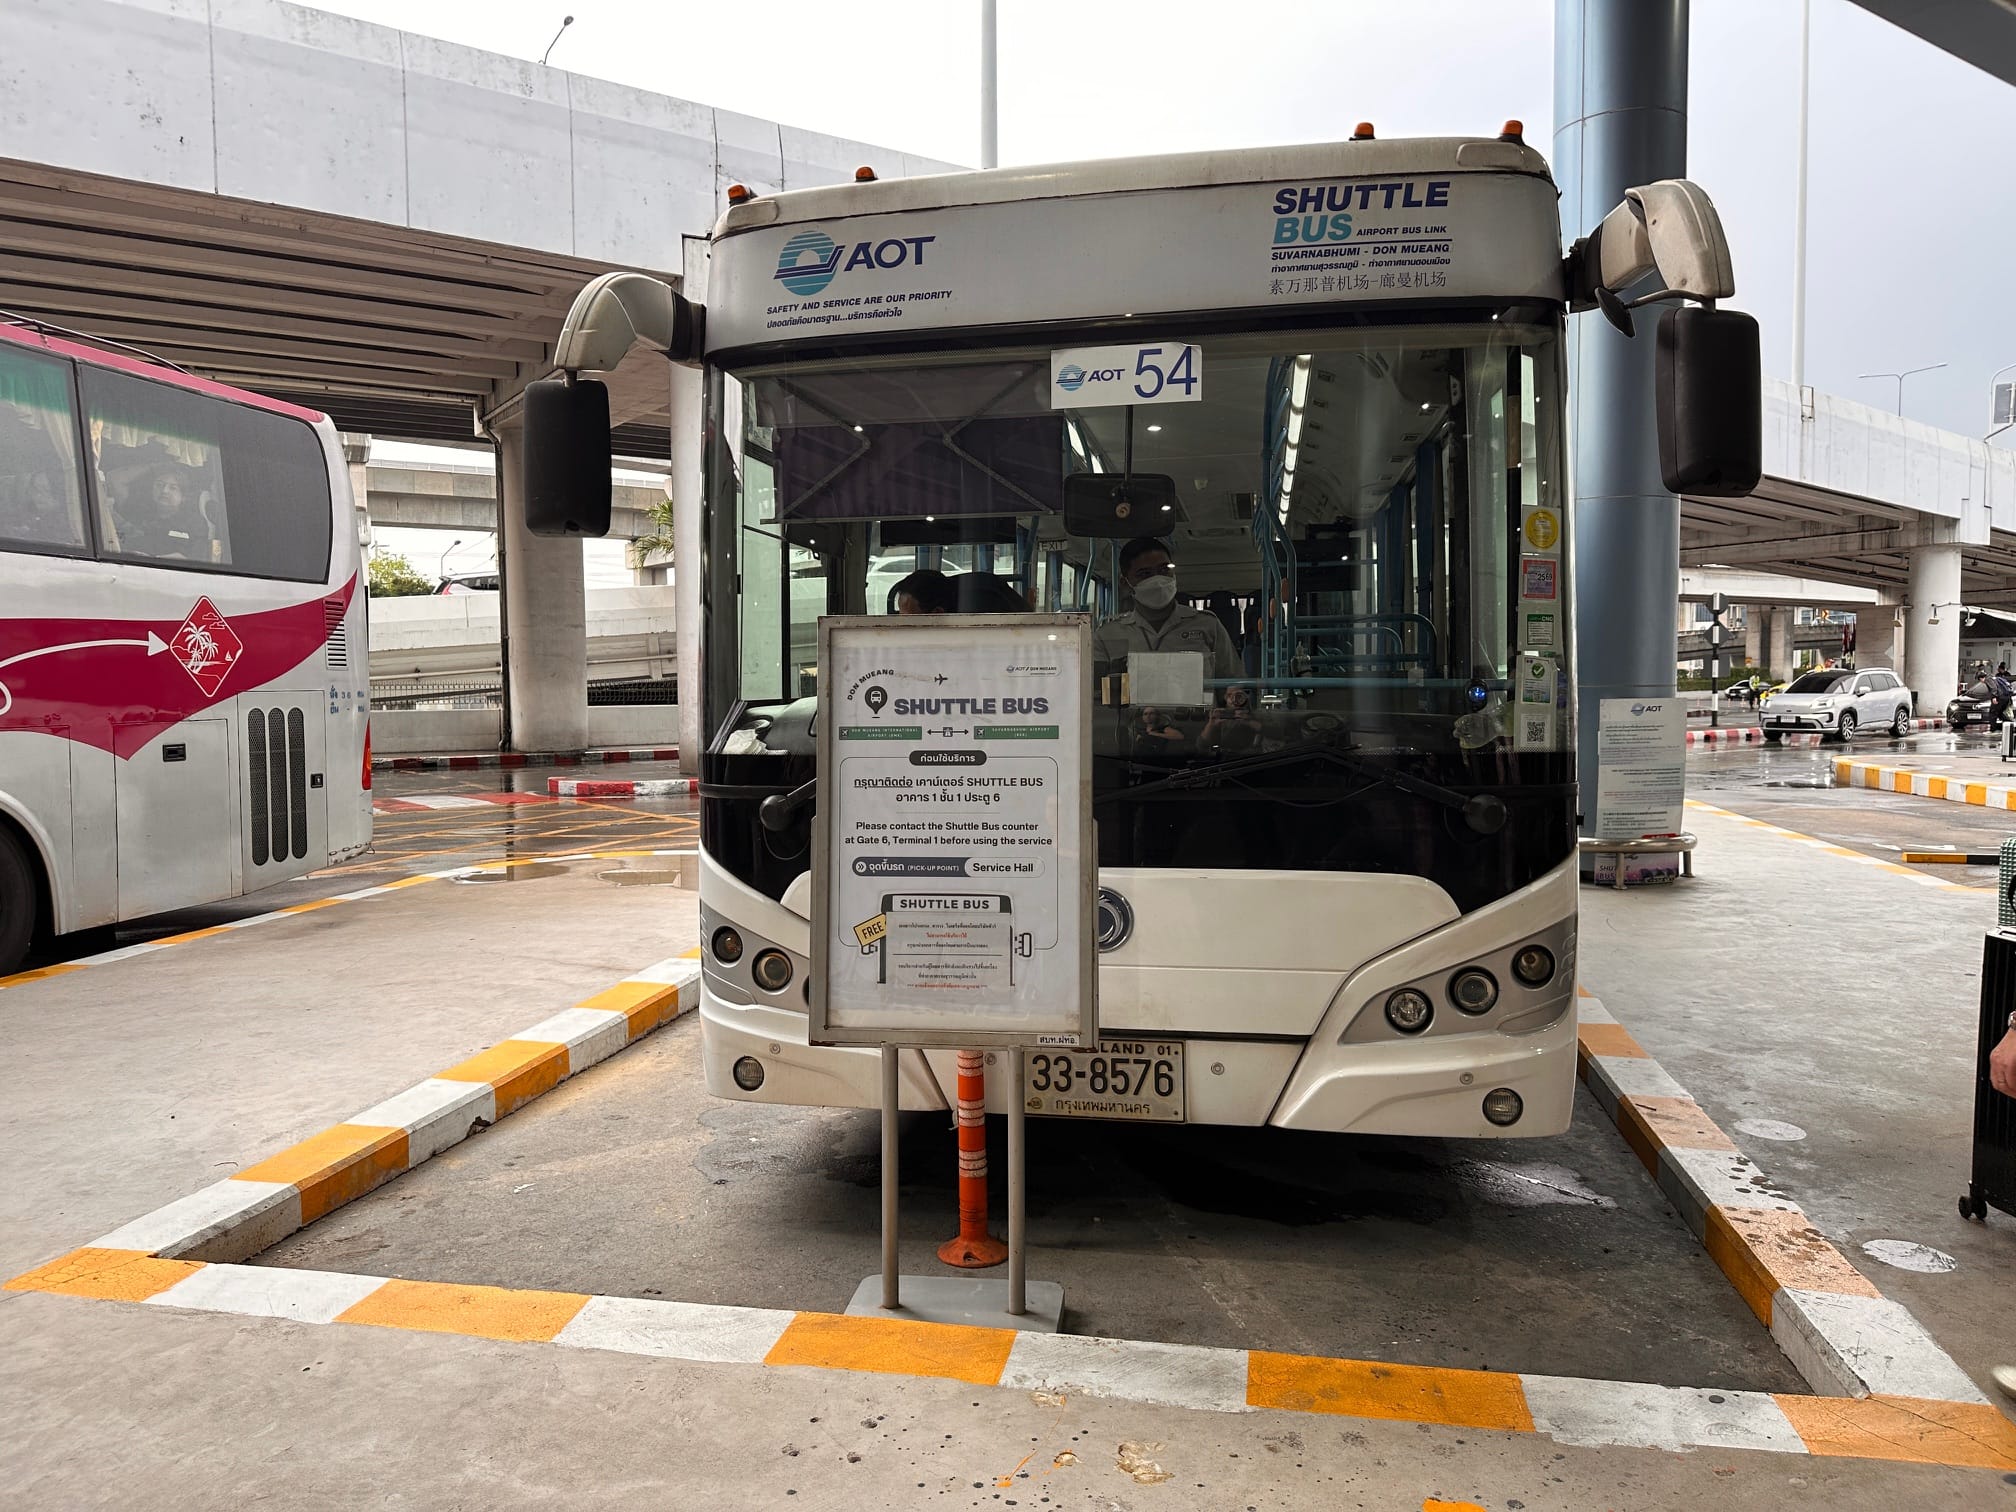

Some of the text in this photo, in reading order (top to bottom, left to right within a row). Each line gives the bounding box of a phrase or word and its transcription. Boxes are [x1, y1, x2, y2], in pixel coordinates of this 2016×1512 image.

[1272, 181, 1451, 215] SHUTTLE
[1273, 213, 1447, 245] BUS AIRPORT BUS LINK
[844, 235, 936, 271] AOT
[1271, 247, 1361, 261] SUVARNABHUMI
[1372, 245, 1397, 255] DON
[1401, 244, 1450, 254] MUEANG
[766, 290, 952, 315] SAFETY AND SERVICE ARE OUR PRIORITY
[1087, 346, 1198, 398] AOT 54
[847, 669, 895, 701] DON MUEANG
[894, 697, 1050, 715] SHUTTLE BUS
[920, 753, 975, 763] ก่อนใช้บริการ
[854, 776, 1043, 789] กรุณาติดต่อ เคาน์เตอร์ SHUTTLE BUS
[896, 789, 1000, 805] อาคาร 1 ชั้น 1 ประตู 6
[856, 822, 1039, 831] Please contact the Shuttle Bus counter
[845, 835, 1053, 847] at Gate 6, Terminal 1 before using the service
[869, 858, 960, 874] จุดขึ้นรถ (PICK-UP POINT)
[973, 863, 1034, 872] Service Hall
[900, 899, 990, 910] SHUTTLE BUS
[862, 921, 885, 939] FREE
[1101, 1042, 1171, 1055] LAND 01
[1032, 1055, 1173, 1097] 33-8576
[1055, 1100, 1151, 1114] กรุงเทพมหานคร
